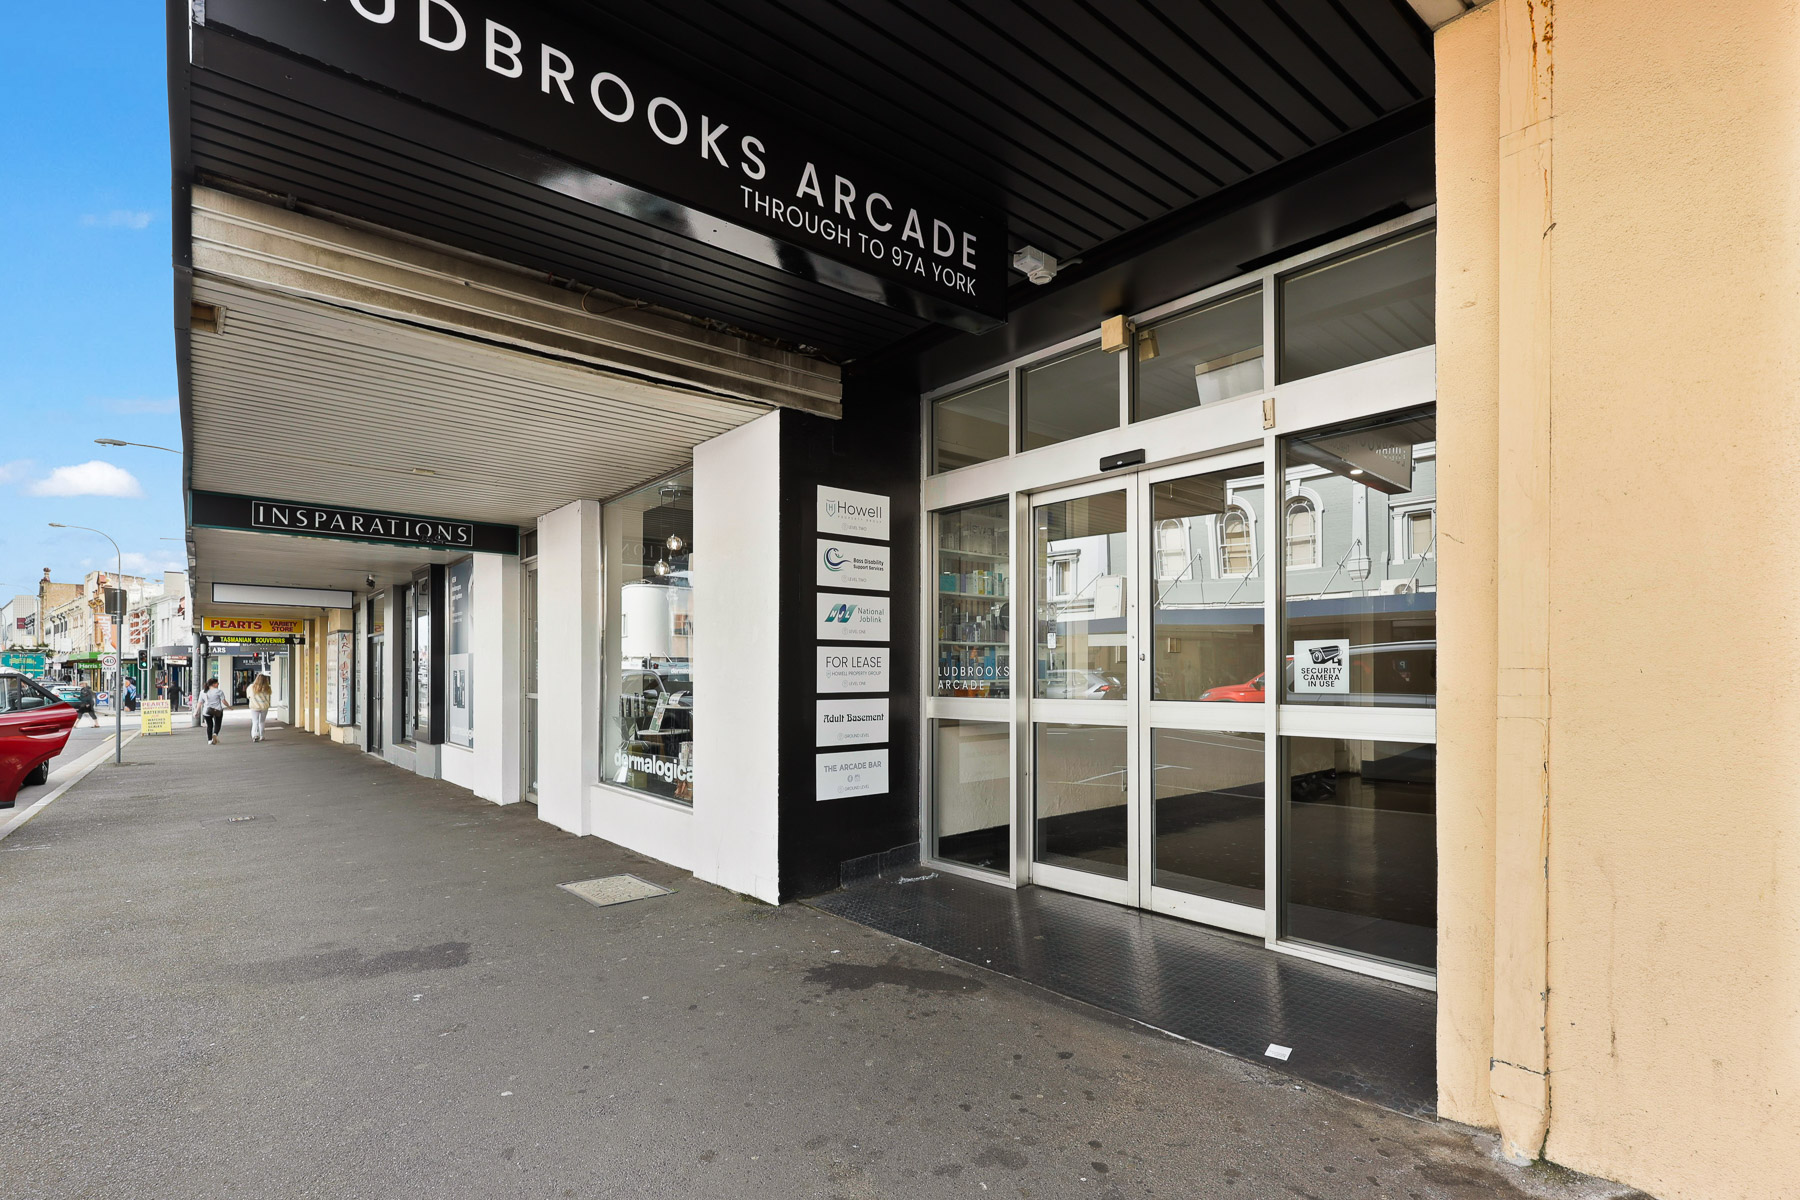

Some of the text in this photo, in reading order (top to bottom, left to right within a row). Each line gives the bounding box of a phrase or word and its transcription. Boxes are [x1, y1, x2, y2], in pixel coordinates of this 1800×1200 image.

[796, 161, 978, 270] ARCADE
[740, 185, 977, 297] THROUGH TO 97A YORK
[837, 501, 882, 519] Howell
[259, 506, 467, 542] INSPARATIONS
[853, 557, 884, 567] Bass Disability
[829, 610, 851, 619] NJL
[857, 607, 885, 616] National
[210, 619, 262, 630] PEARTS
[859, 615, 882, 623] Joblink
[341, 634, 350, 656] ART
[826, 656, 882, 668] FOR LEASE
[938, 666, 1010, 677] LUDBROOKS
[937, 679, 985, 690] ARCADE
[1319, 680, 1335, 688] USE
[823, 713, 884, 723] Adult Basement
[614, 749, 693, 783] dermalogica
[824, 760, 882, 773] THE ARCADE BAR
